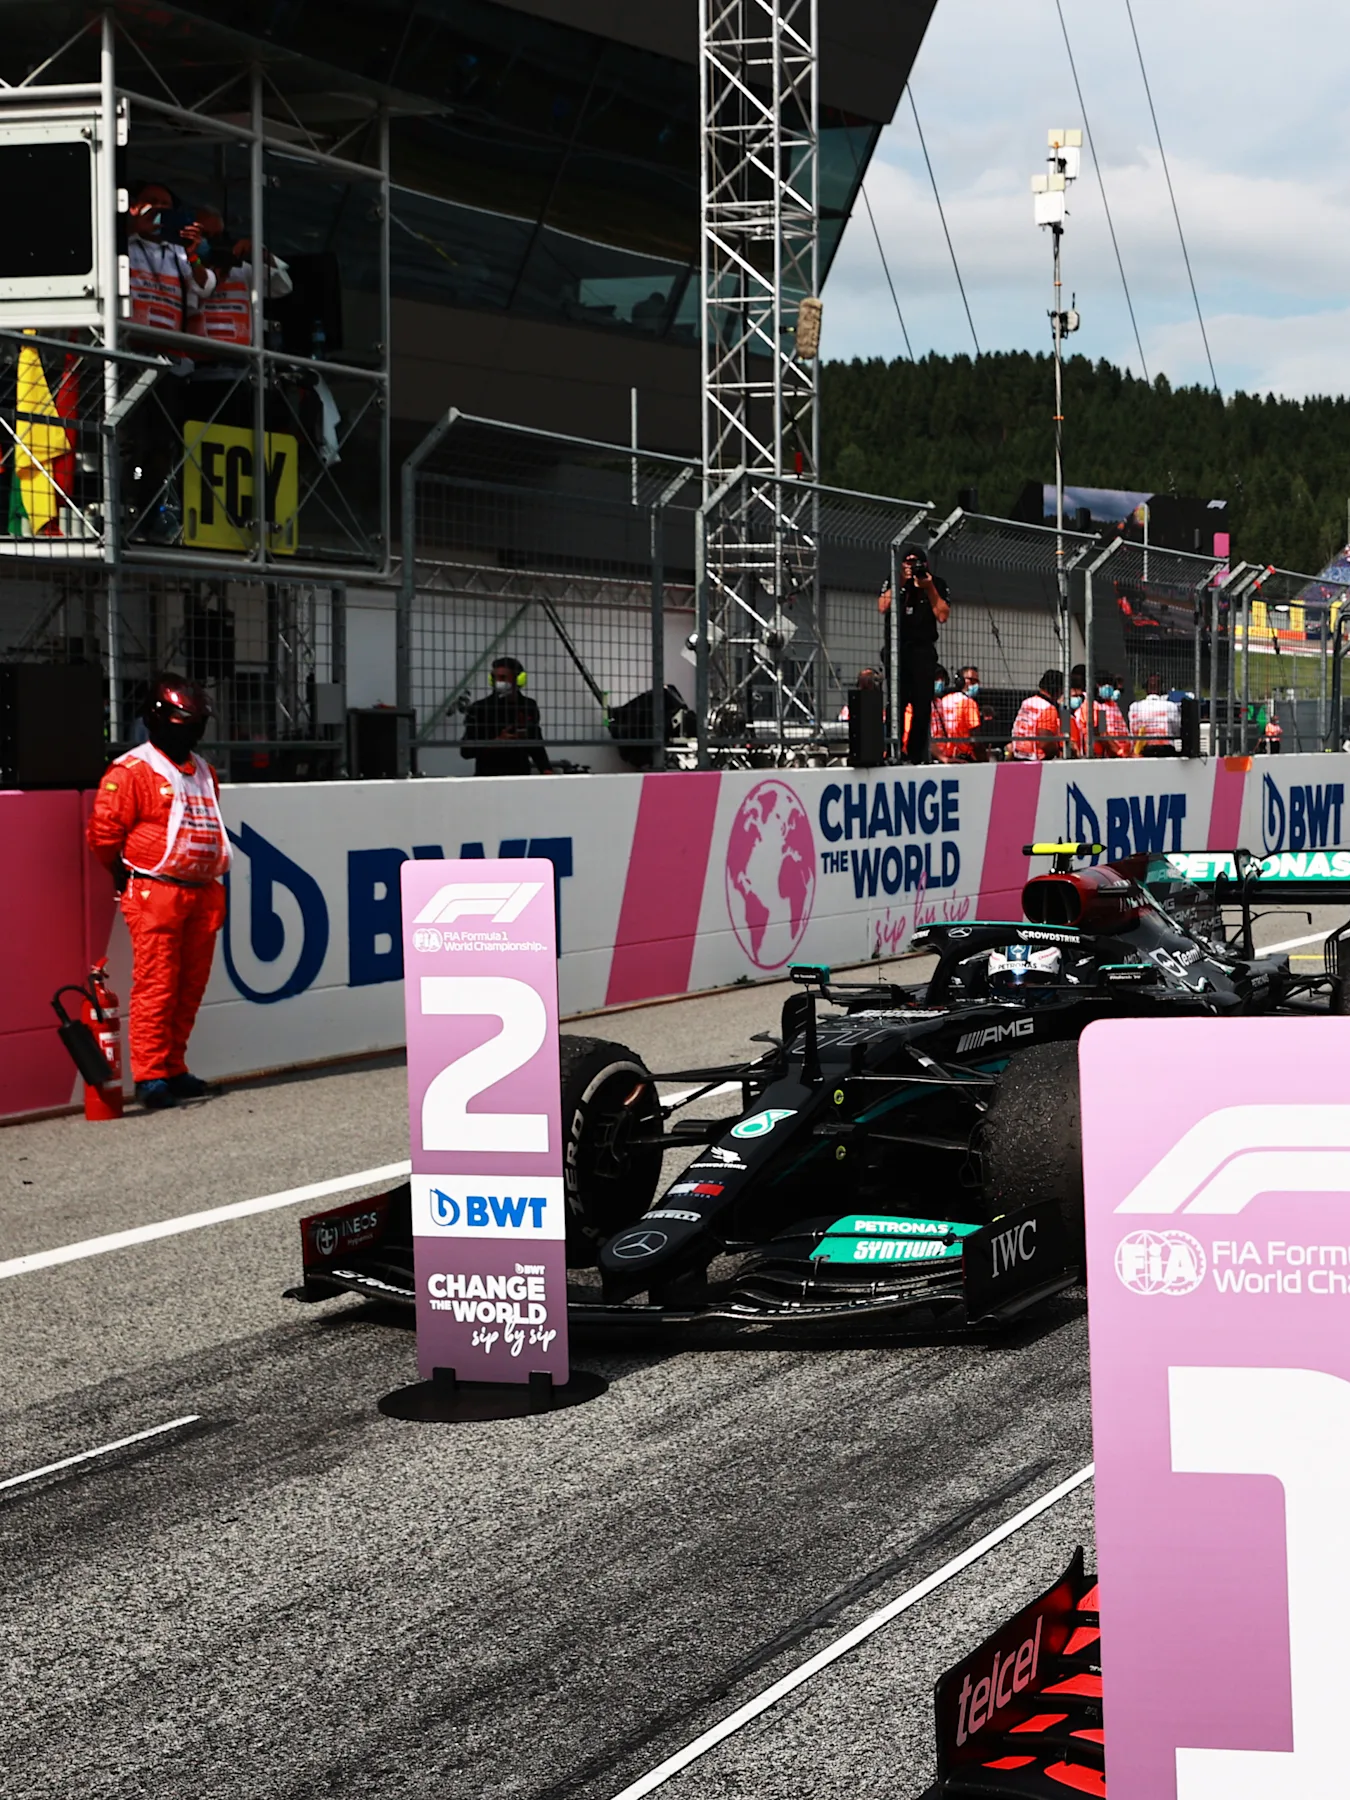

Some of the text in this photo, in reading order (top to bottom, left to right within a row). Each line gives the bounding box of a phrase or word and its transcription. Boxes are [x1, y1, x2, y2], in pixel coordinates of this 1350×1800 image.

[200, 441, 287, 528] FCY
[819, 780, 960, 842] CHANGE
[1289, 783, 1345, 850] BWT
[1106, 793, 1187, 863] BWT
[821, 841, 961, 899] THE WORLD
[348, 837, 573, 988] BT
[443, 931, 509, 941] FIA Formula 1
[444, 942, 473, 951] World
[1022, 930, 1081, 943] CROWDSTRIKE
[998, 962, 1038, 970] PETRONAS
[981, 1017, 1034, 1047] AMG
[420, 976, 549, 1154] 2
[342, 1211, 378, 1237] INEOS
[466, 1195, 548, 1229] BWT
[854, 1220, 949, 1234] PETRONAS
[853, 1240, 947, 1260] SYNTIUM
[991, 1219, 1037, 1278] IWC
[1212, 1241, 1262, 1265] FIA
[524, 1265, 546, 1275] BWT
[1212, 1269, 1302, 1294] World
[428, 1273, 547, 1301] CHANGE
[430, 1299, 548, 1325] THE WORLD
[471, 1314, 557, 1357] sip by sip
[956, 1614, 1044, 1748] telcel
